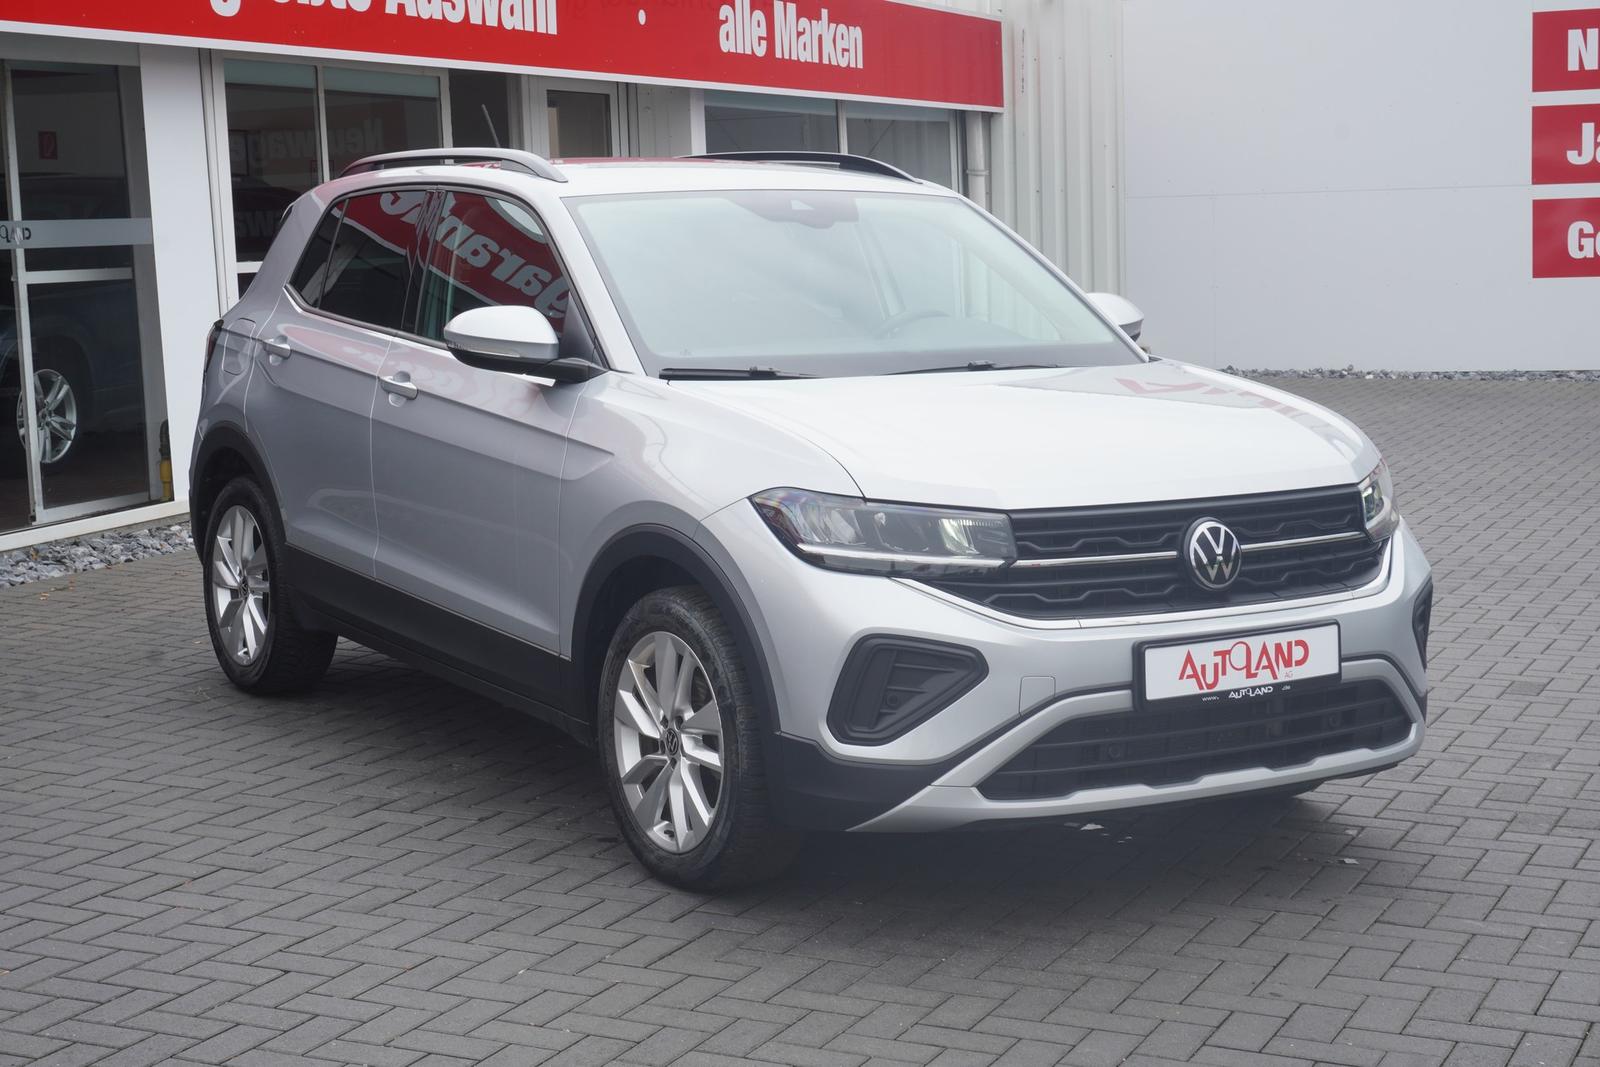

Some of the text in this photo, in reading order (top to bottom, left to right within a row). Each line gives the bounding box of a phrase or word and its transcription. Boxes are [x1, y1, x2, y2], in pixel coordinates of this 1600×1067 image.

[718, 0, 864, 69] alle Marken
[1566, 122, 1600, 165] J
